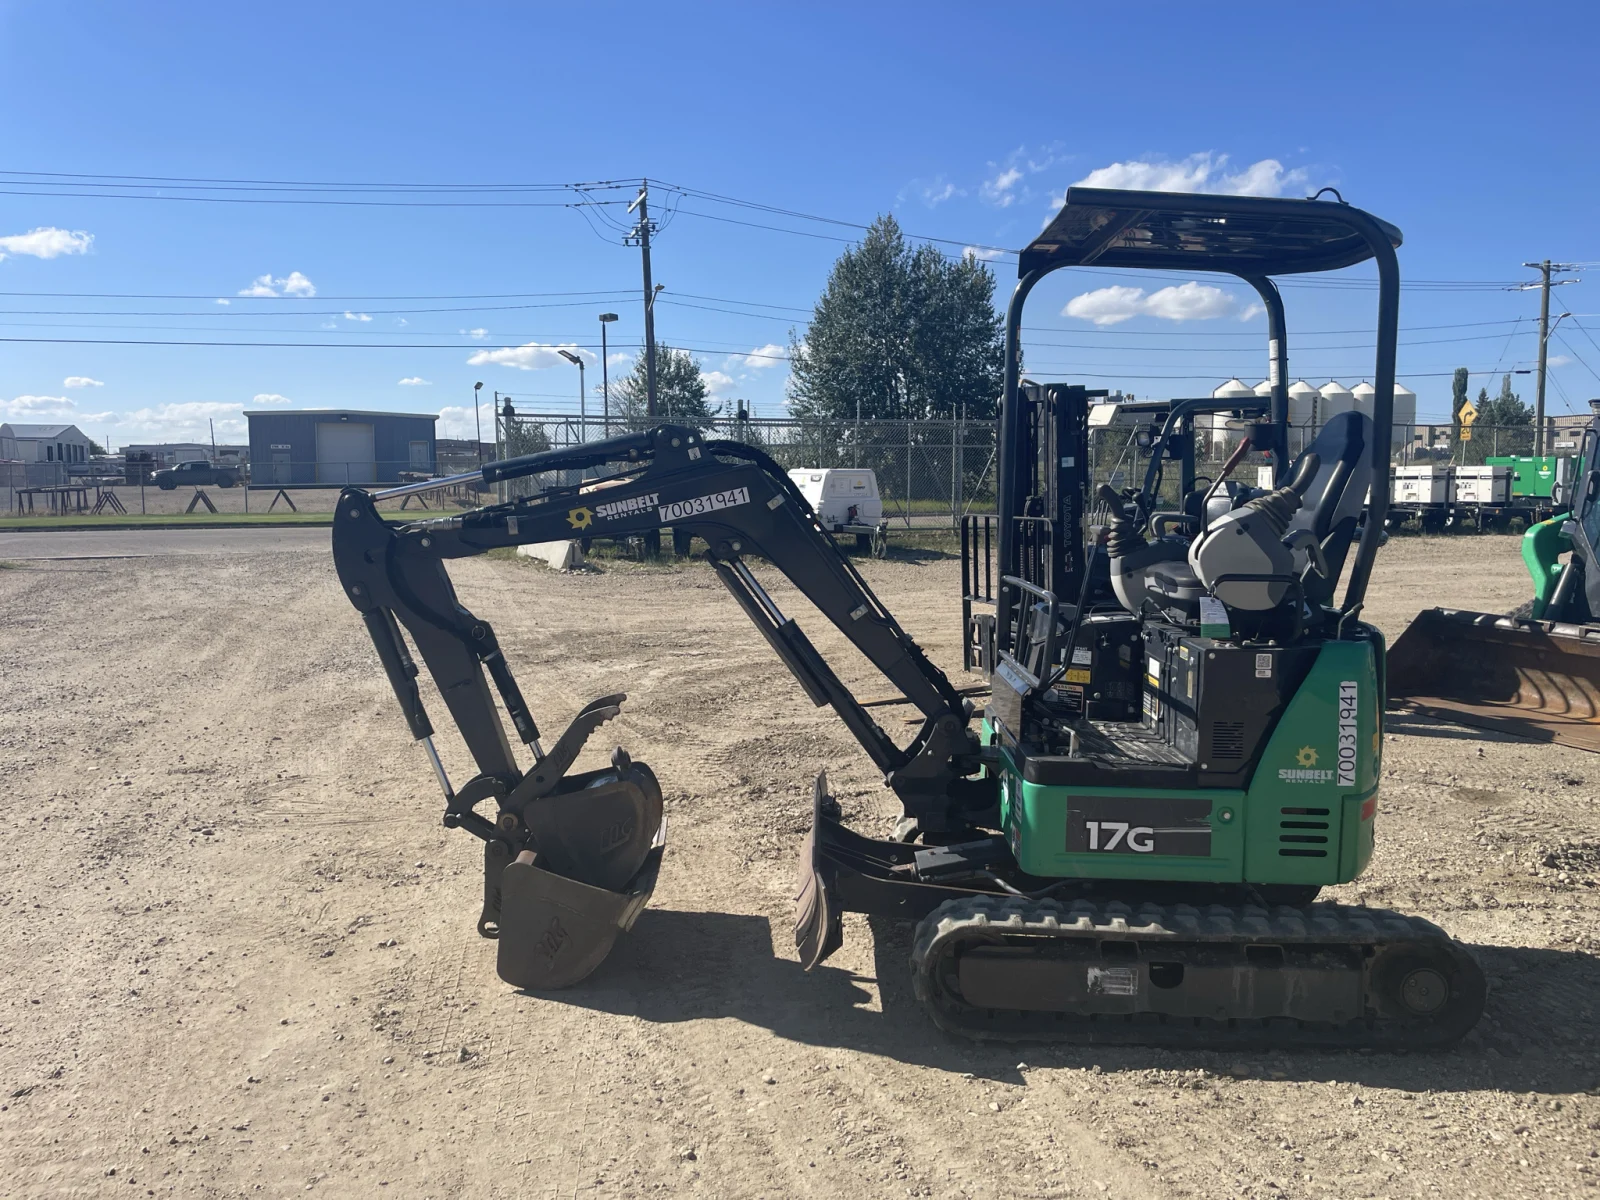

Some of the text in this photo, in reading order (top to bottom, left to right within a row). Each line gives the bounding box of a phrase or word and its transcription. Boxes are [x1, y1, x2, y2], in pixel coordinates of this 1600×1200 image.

[596, 493, 660, 518] SUNBELT
[606, 506, 653, 521] RENTALS
[661, 487, 747, 522] 70031941
[1063, 494, 1073, 547] TOYOTA
[1338, 683, 1356, 785] 70031941
[1278, 769, 1334, 780] SUNBELT
[1086, 821, 1154, 853] 17G
